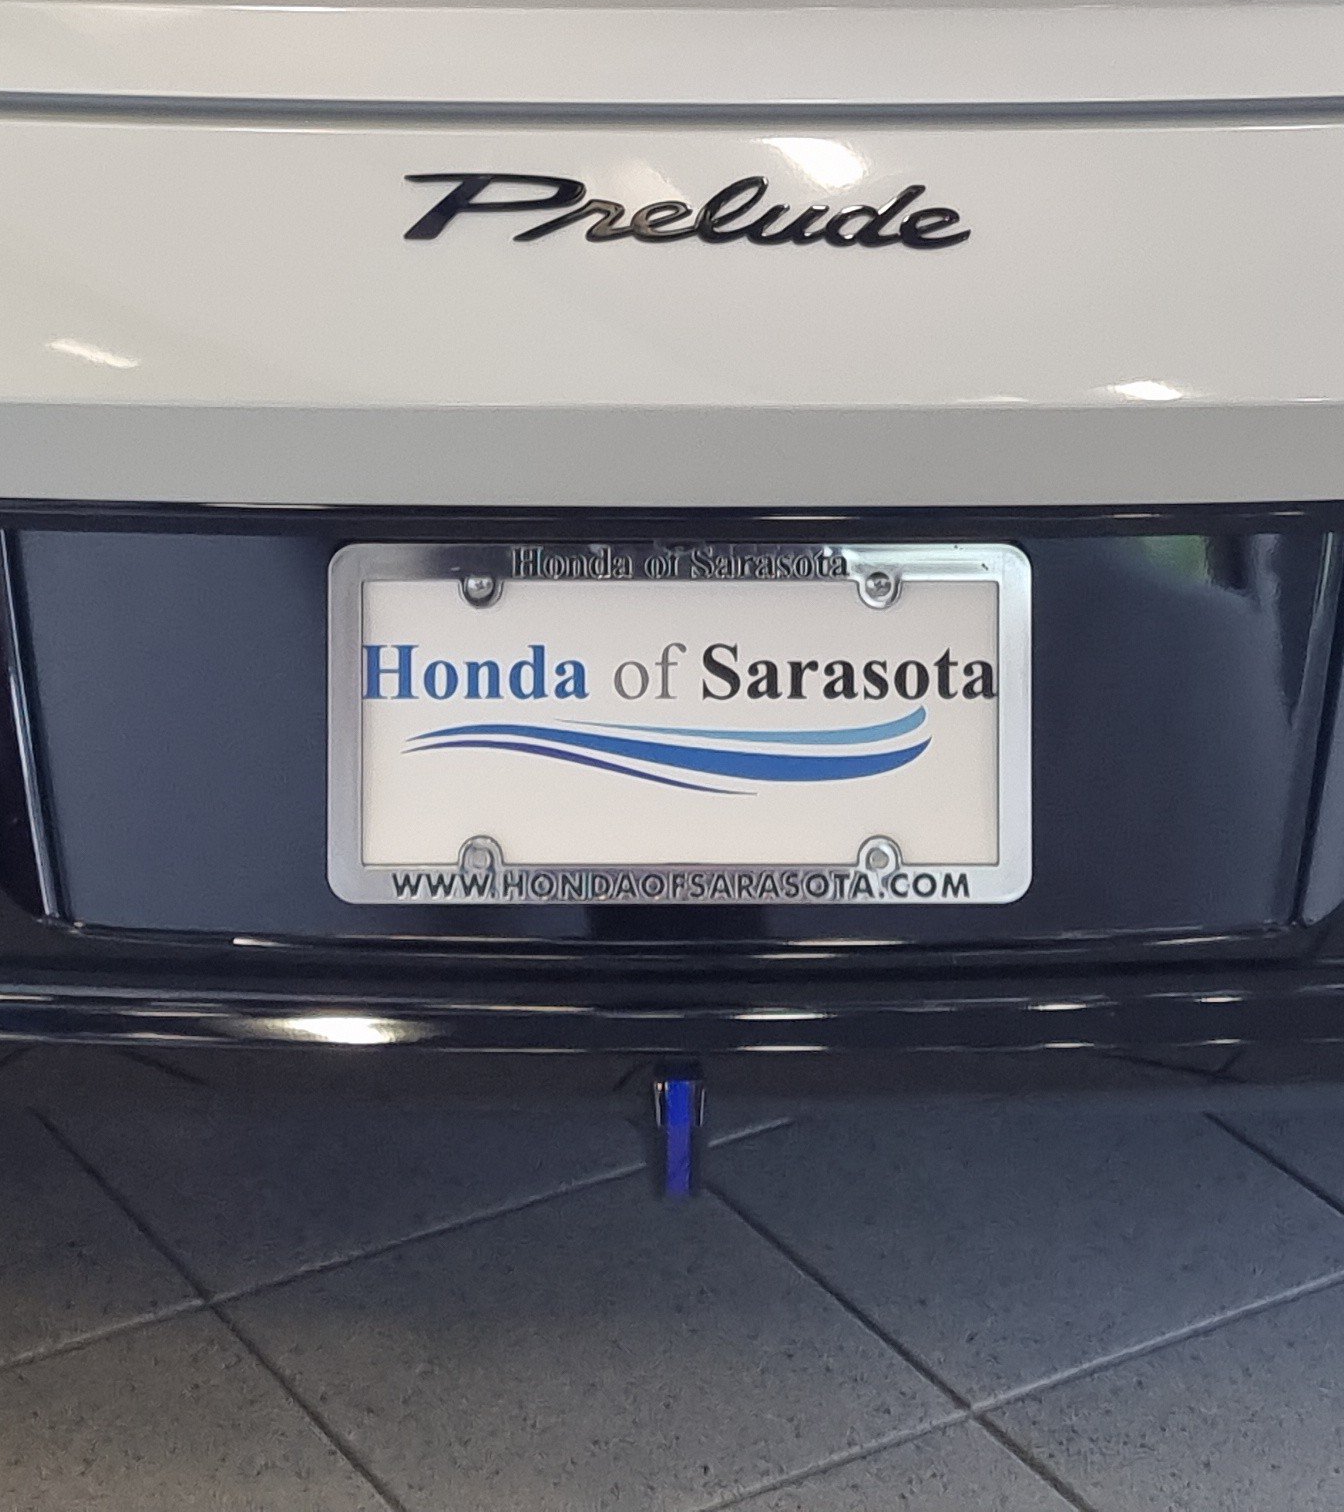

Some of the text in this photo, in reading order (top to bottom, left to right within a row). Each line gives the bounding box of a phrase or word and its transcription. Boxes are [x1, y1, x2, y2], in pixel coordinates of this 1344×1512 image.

[403, 172, 972, 250] Prelude
[511, 544, 851, 580] Honda of Sarasota
[362, 642, 998, 701] Honda of Sarasota
[392, 871, 971, 899] WWW.HONDAOFSARASOTA.COM
